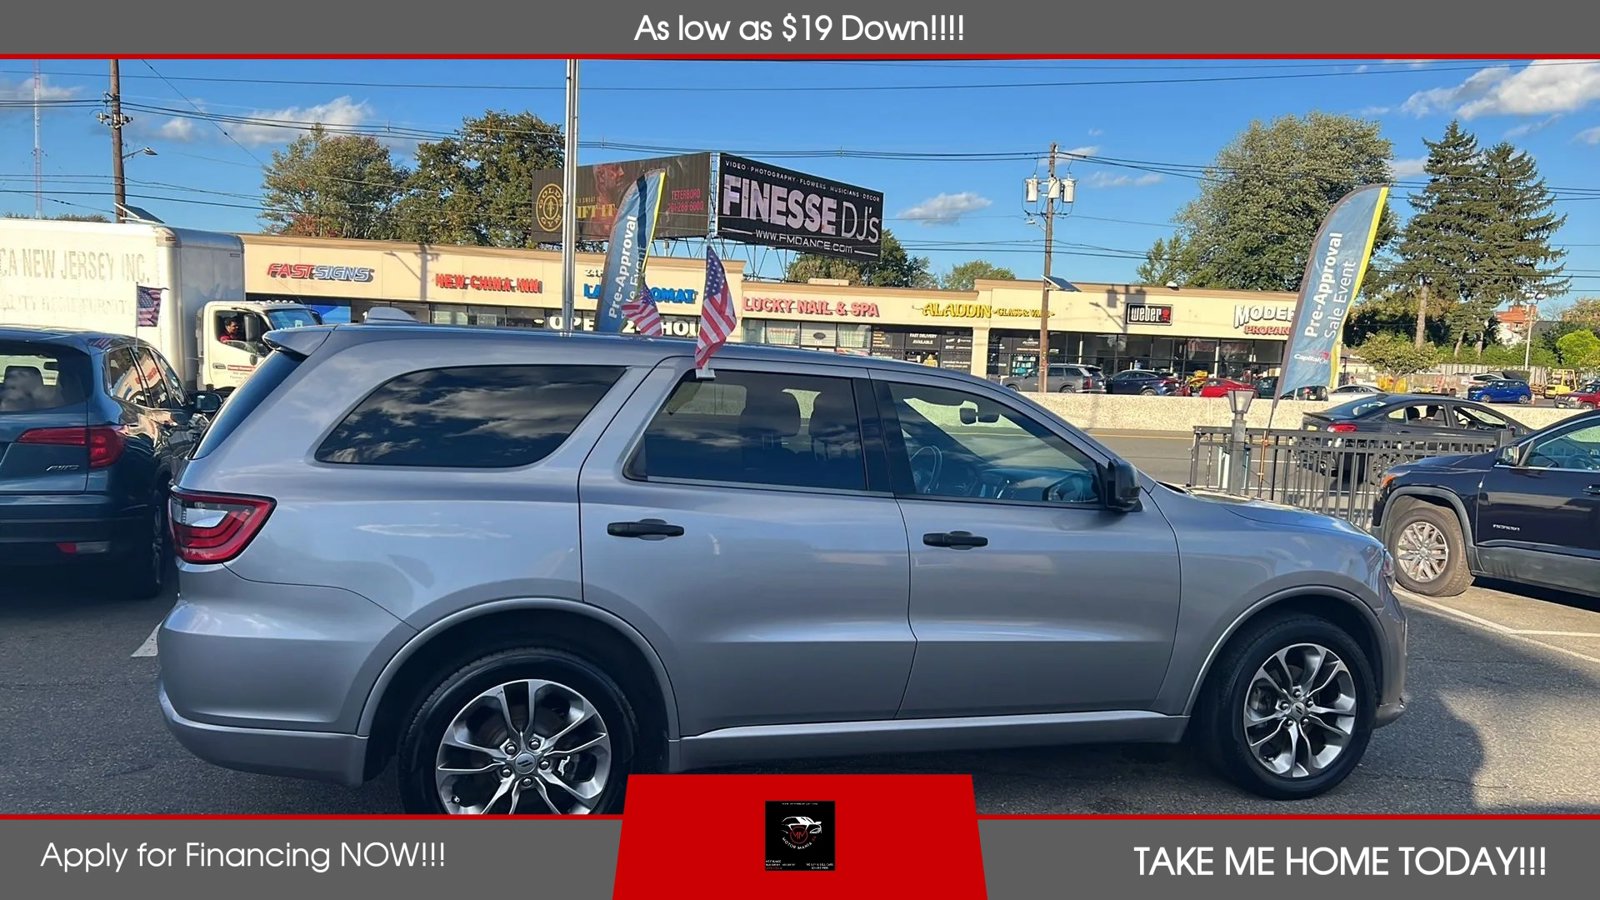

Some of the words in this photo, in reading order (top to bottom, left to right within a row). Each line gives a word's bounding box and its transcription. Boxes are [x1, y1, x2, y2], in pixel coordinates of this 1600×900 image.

[725, 160, 747, 171] VIDEO
[750, 166, 796, 181] PHOTOGRAPHY
[799, 178, 827, 190] FLOWERS
[829, 185, 860, 198] MUSICIANS
[862, 193, 880, 202] DECOR
[722, 174, 838, 236] FINESSE
[841, 201, 880, 244] DJ's
[22, 248, 56, 279] NEW
[60, 250, 115, 281] JERSEY
[121, 253, 151, 283] INC.
[267, 262, 375, 282] FASTSIGNS
[608, 215, 638, 319] Pre-Approval
[435, 273, 466, 291] NEW
[469, 275, 514, 293] CHINA
[516, 277, 543, 294] INN
[1304, 232, 1343, 338] Pre-Approval
[1332, 260, 1356, 303] Event
[743, 297, 794, 313] LUCKY
[797, 300, 833, 316] NAIL
[835, 301, 848, 316] &
[851, 302, 880, 317] SPA
[922, 303, 992, 318] ALADDIN
[1130, 305, 1162, 322] weber
[1233, 304, 1295, 329] MODER
[549, 316, 595, 332] OPE
[1244, 325, 1291, 336] PROPAN
[1324, 308, 1344, 339] Sale
